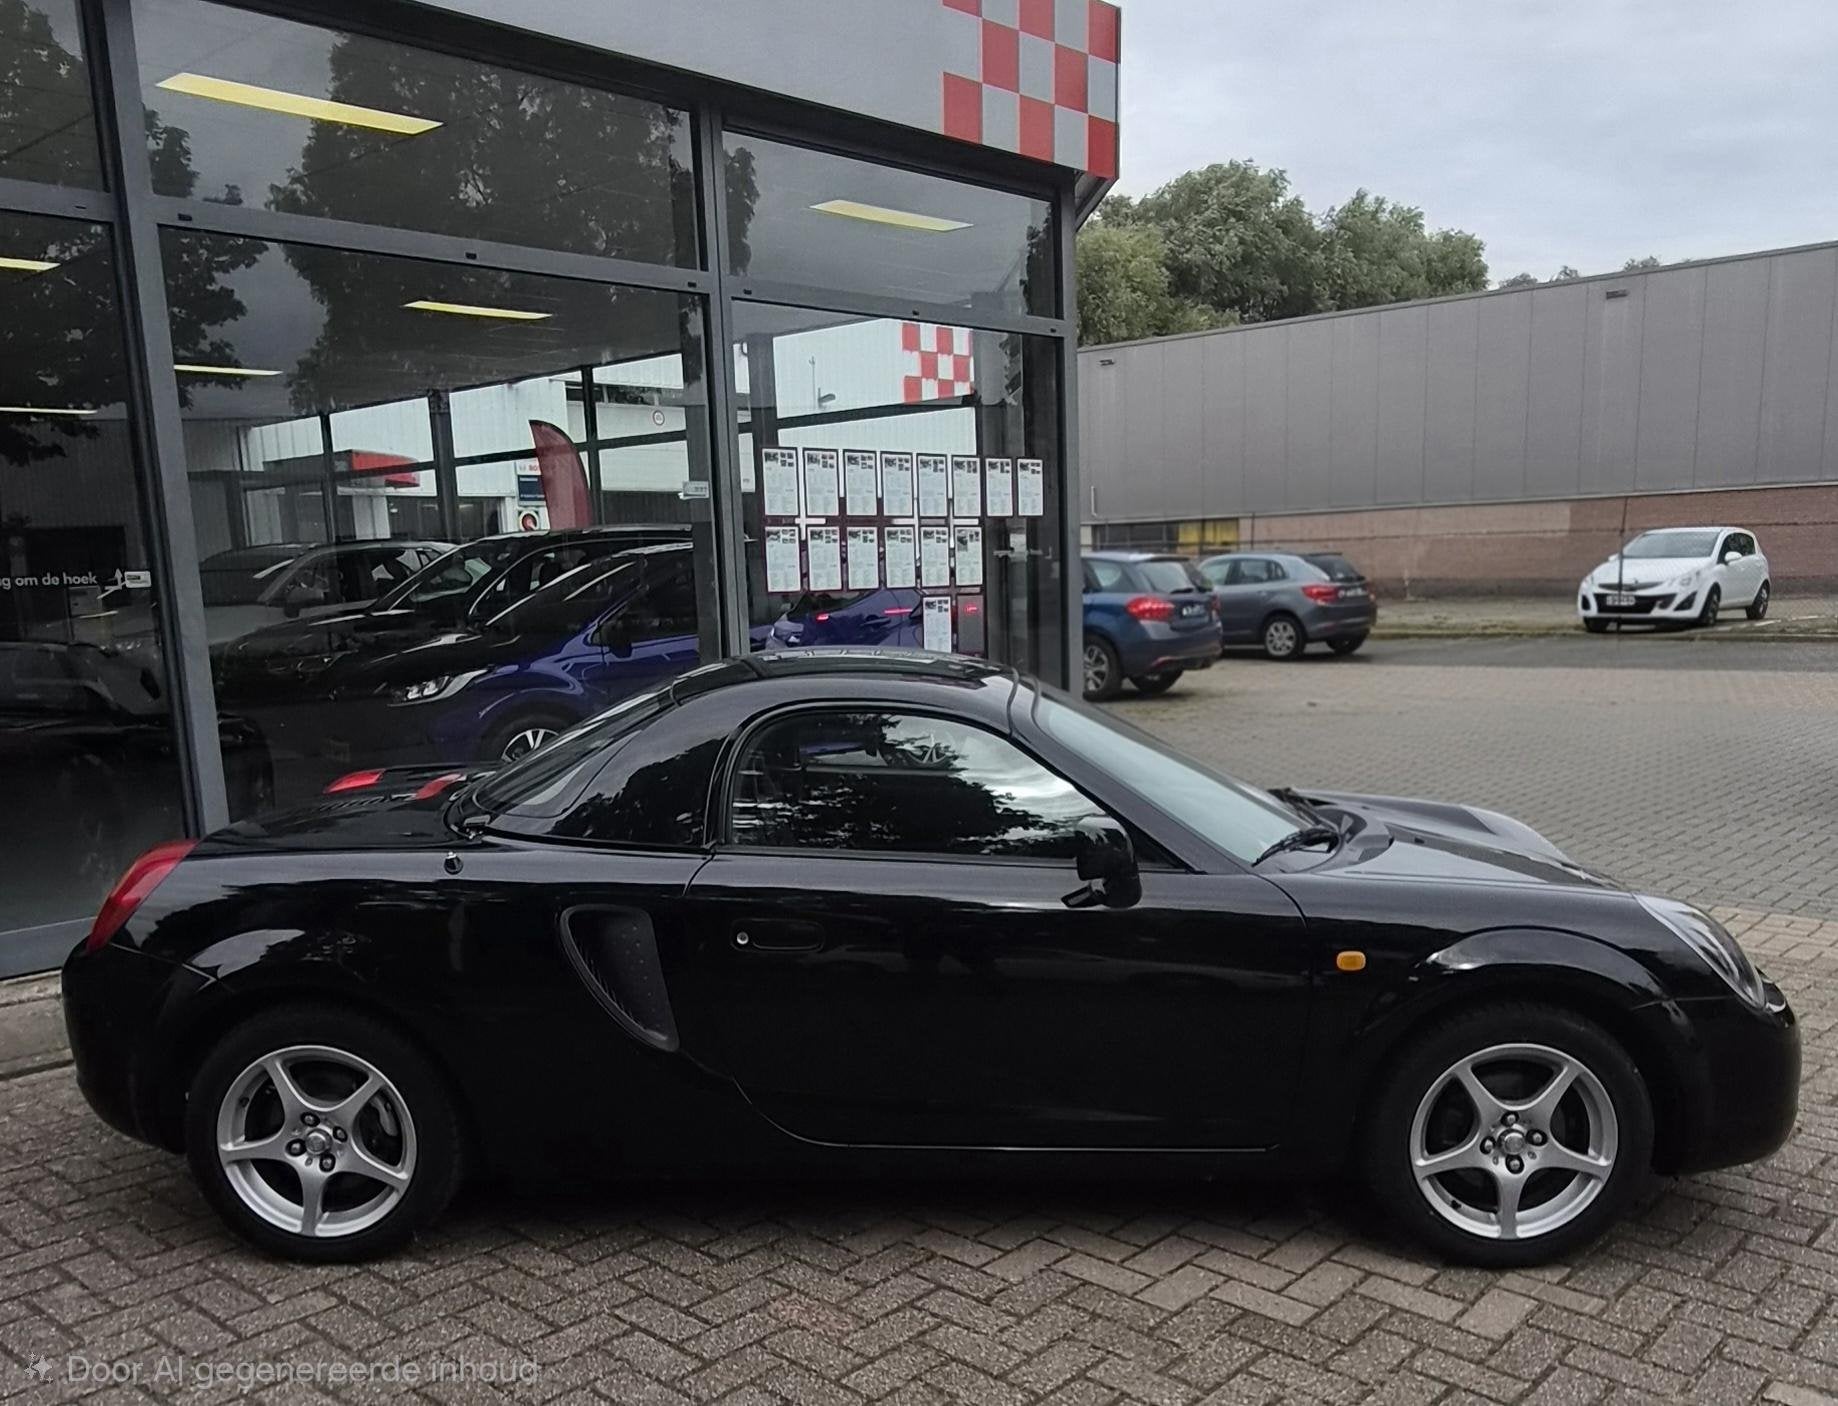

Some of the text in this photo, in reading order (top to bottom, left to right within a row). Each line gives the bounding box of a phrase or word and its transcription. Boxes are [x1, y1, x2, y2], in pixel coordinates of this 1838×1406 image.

[0, 571, 98, 590] g om de hoek
